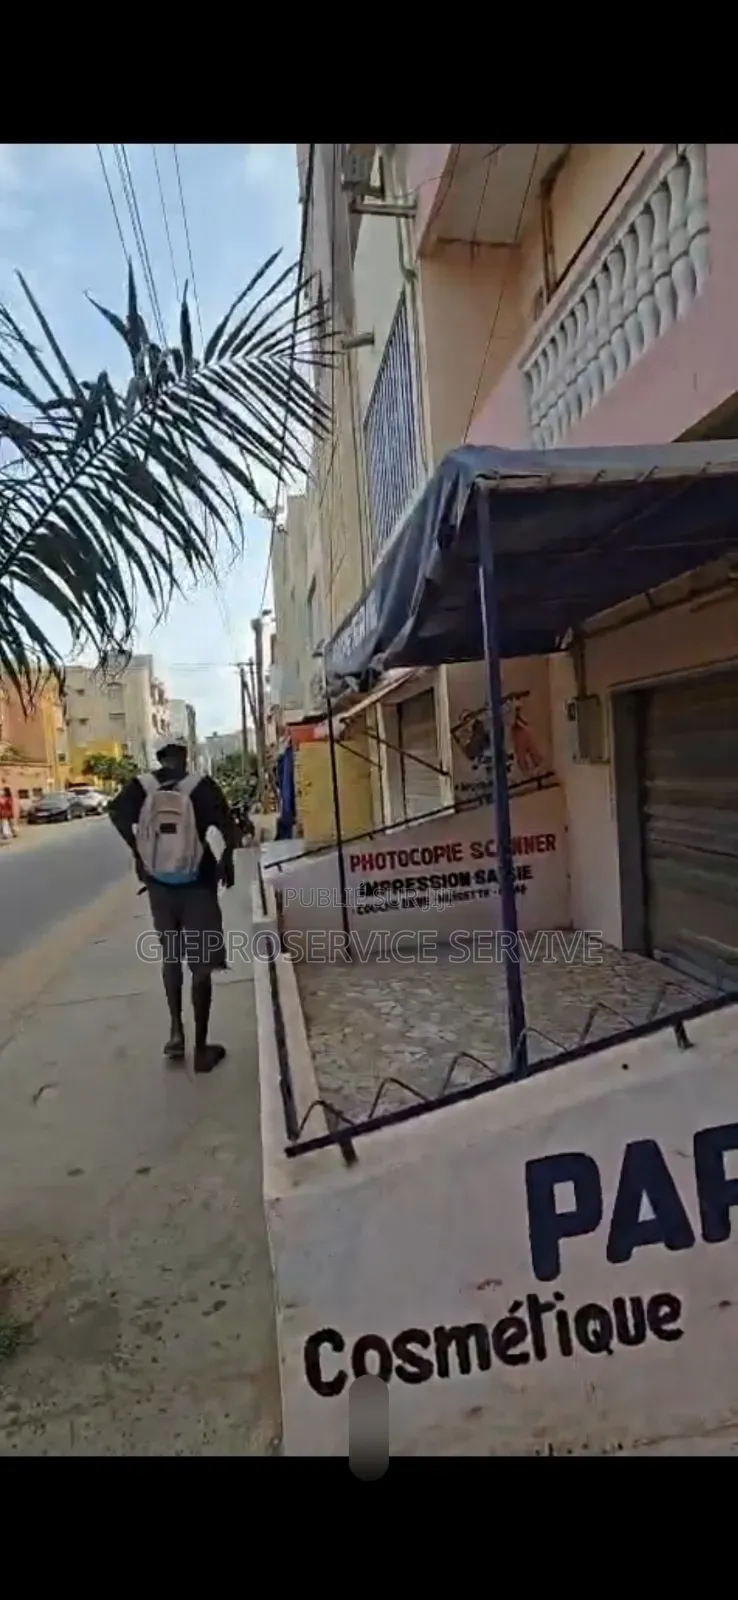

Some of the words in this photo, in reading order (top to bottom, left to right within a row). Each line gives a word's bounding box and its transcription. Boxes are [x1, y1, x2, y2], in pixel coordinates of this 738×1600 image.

[350, 842, 463, 873] PHOTOCOPIE
[470, 833, 557, 861] SCNNER
[474, 865, 534, 889] SAIE
[304, 1291, 684, 1397] Cosmétique
